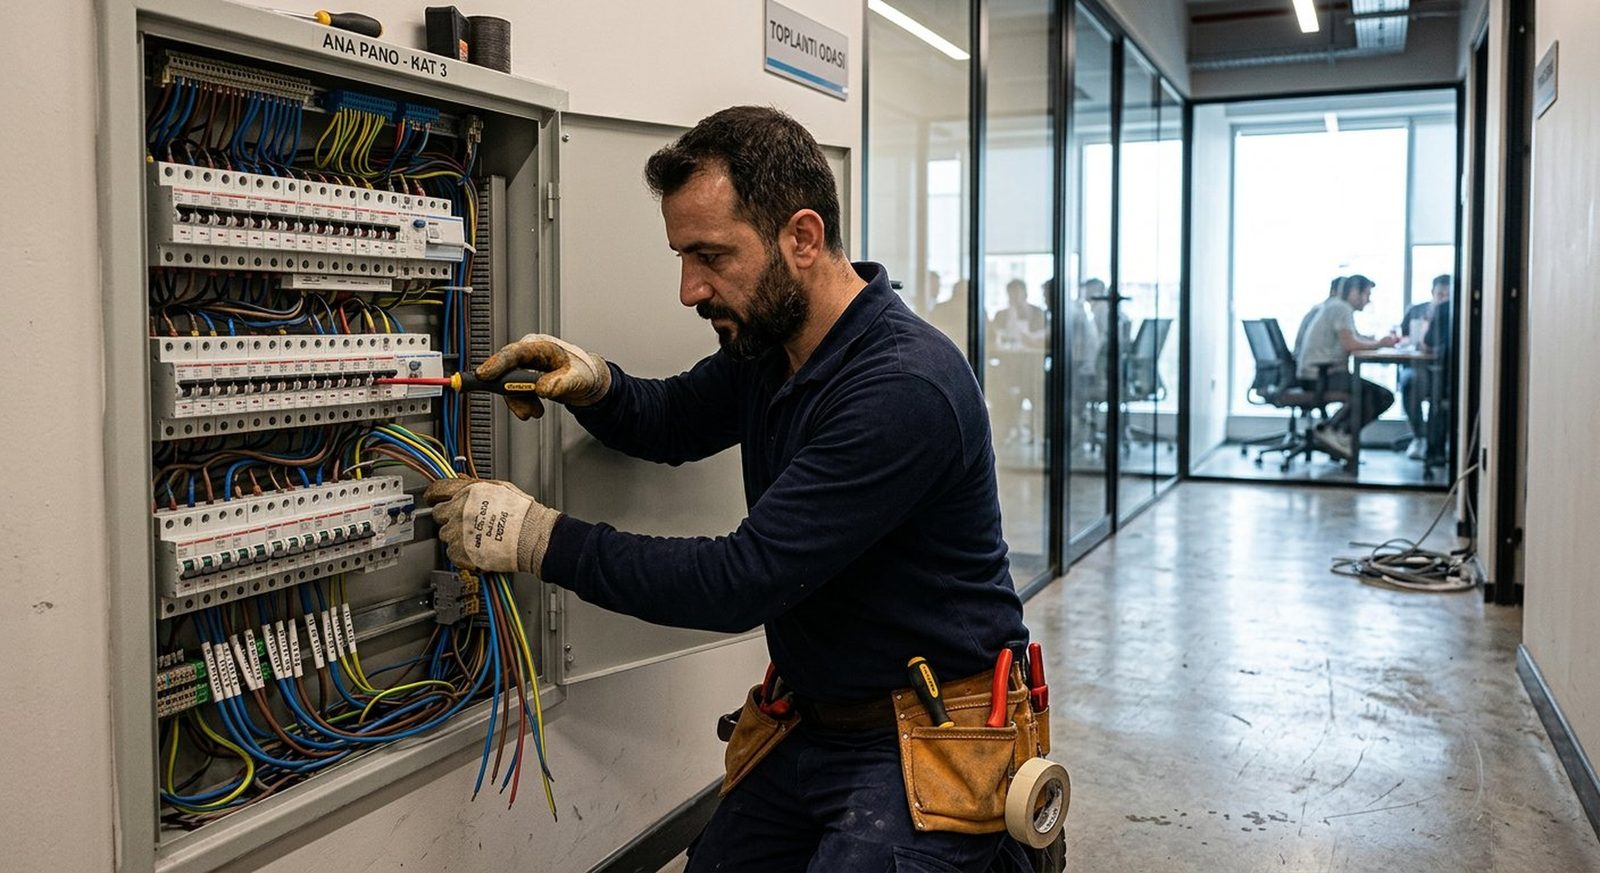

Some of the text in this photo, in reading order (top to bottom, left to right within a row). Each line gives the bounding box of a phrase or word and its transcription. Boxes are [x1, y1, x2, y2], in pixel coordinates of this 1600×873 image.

[322, 33, 356, 55] ANA
[360, 42, 399, 65] PANO
[411, 55, 437, 75] KAT
[440, 63, 447, 77] 3
[769, 20, 846, 69] TOPLANTI ODASI
